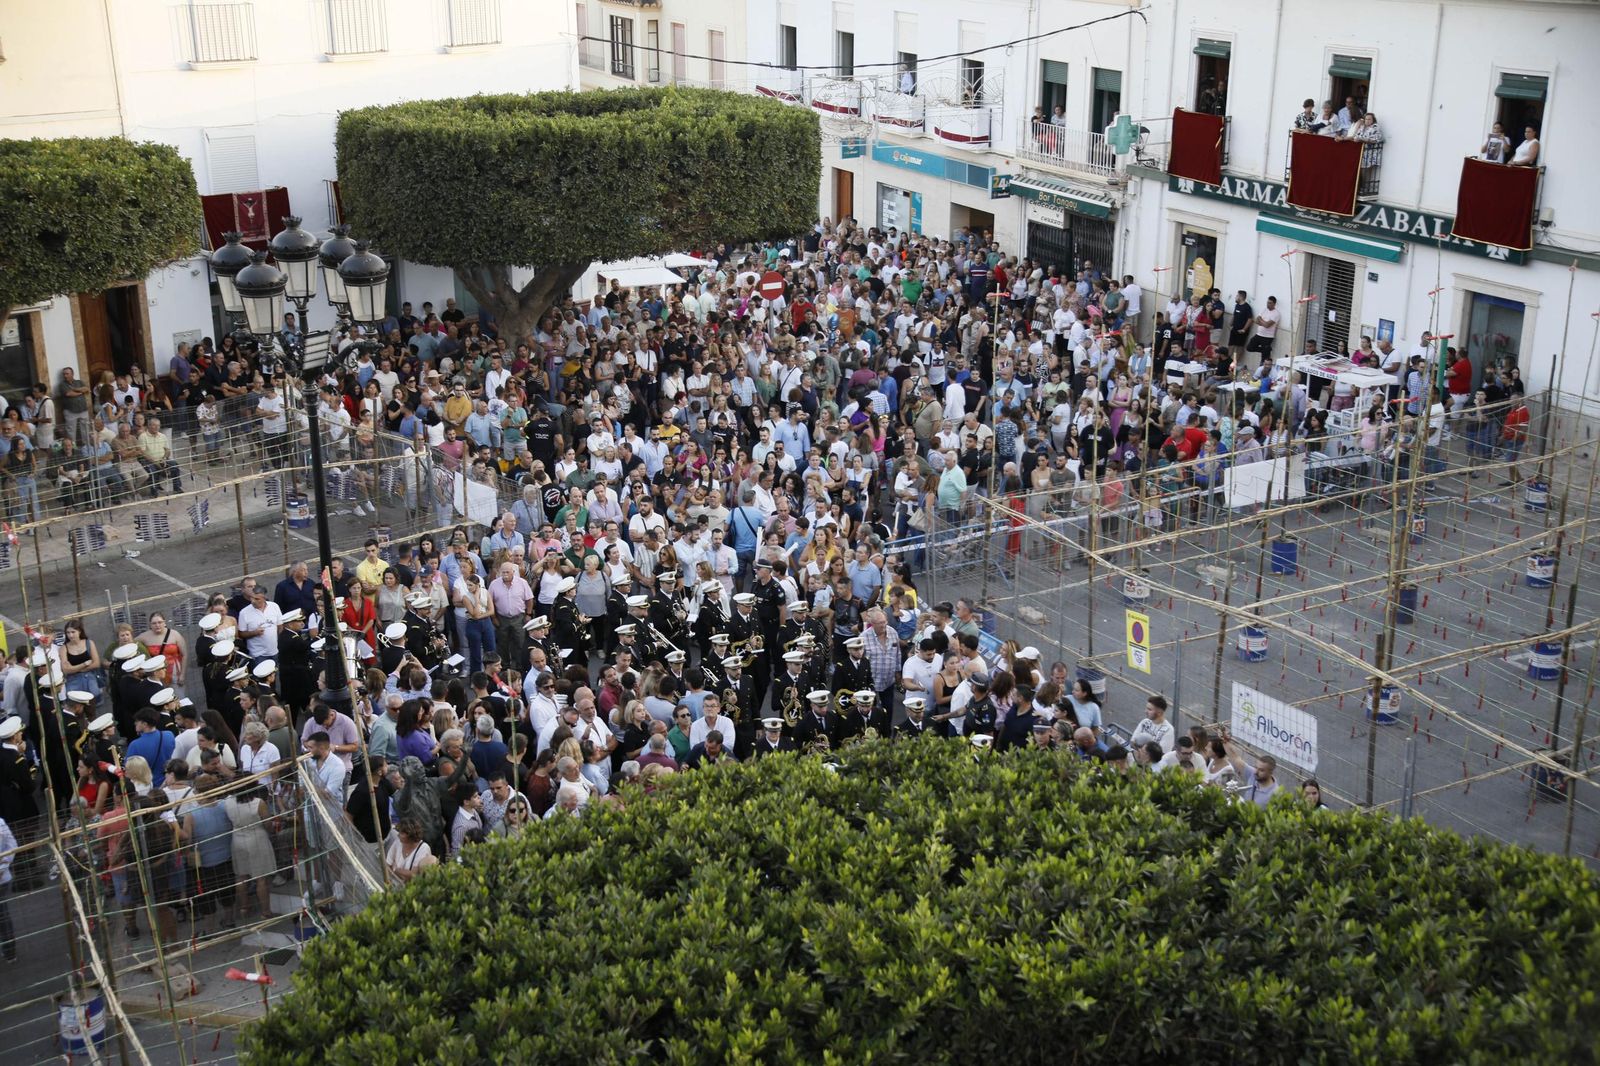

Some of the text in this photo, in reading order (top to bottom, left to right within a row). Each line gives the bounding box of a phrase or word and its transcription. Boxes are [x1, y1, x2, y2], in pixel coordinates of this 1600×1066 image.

[1038, 191, 1050, 203] Bar
[1352, 203, 1474, 247] ZABAL
[1257, 715, 1312, 754] Alborán
